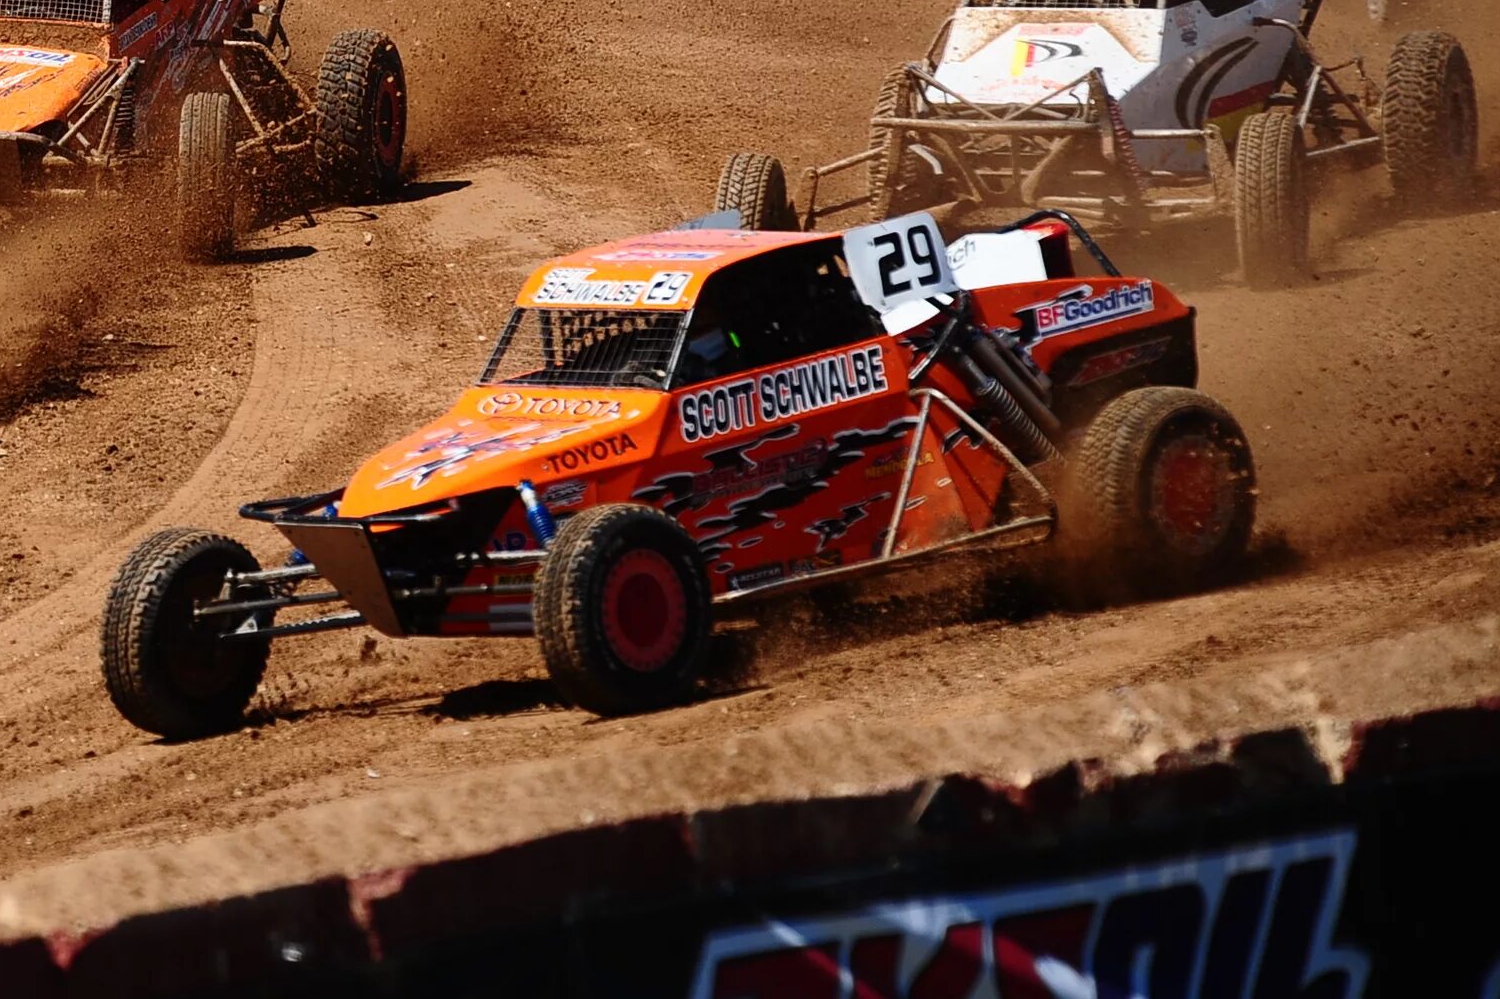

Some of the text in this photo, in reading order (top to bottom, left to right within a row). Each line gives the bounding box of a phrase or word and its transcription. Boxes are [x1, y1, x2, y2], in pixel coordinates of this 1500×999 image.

[873, 224, 942, 298] 29
[537, 272, 690, 302] SCHWALBE 29
[1037, 282, 1152, 328] BFGoodrich
[524, 397, 622, 417] TOYOTA
[681, 344, 889, 442] SCOTT SCHWALBE
[547, 433, 638, 474] TOYOTA
